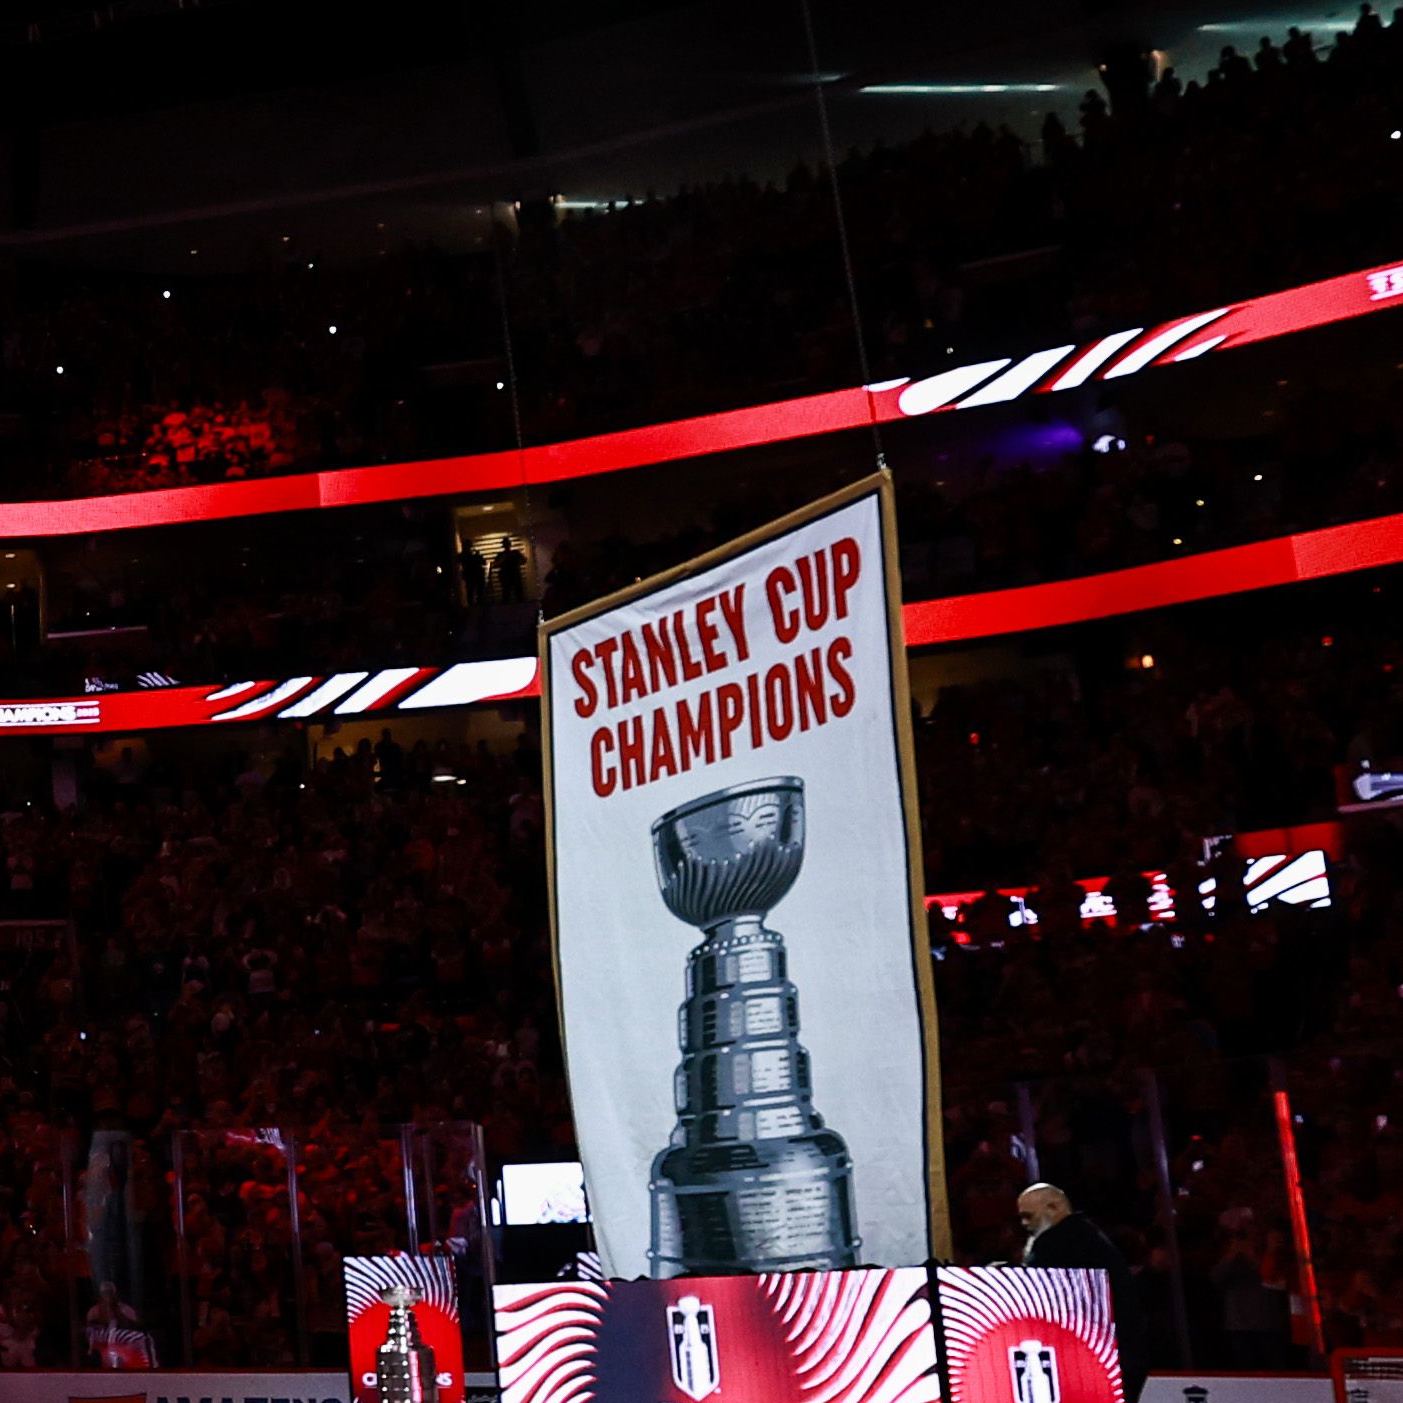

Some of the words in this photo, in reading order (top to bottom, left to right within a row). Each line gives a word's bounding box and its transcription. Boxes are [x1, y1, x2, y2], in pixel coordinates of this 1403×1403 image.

[572, 584, 749, 717] STANLEY
[766, 537, 860, 643] CUP
[591, 637, 855, 797] CHAMPIONS
